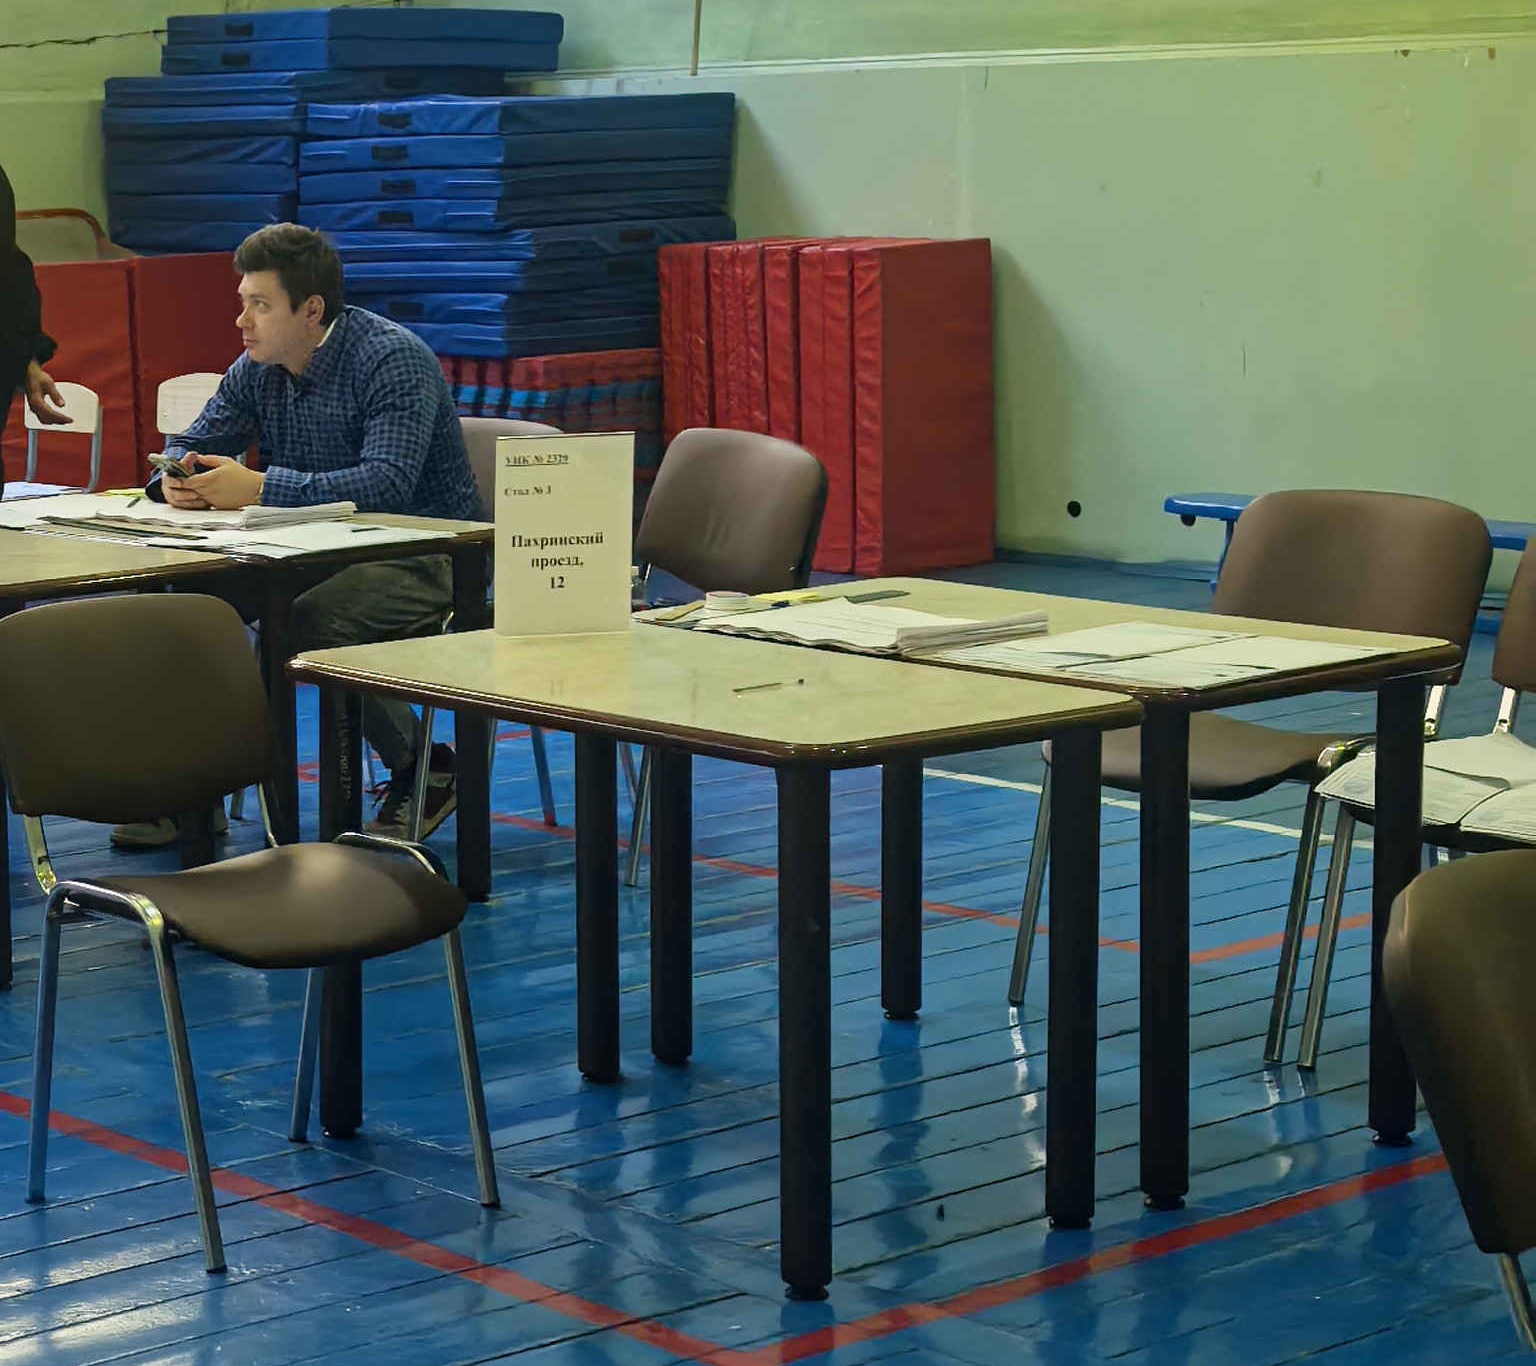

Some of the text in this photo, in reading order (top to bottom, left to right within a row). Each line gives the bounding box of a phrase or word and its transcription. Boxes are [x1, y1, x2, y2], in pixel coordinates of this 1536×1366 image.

[511, 532, 603, 550] Пахринский
[531, 556, 584, 571] проезд,
[550, 576, 565, 589] 12
